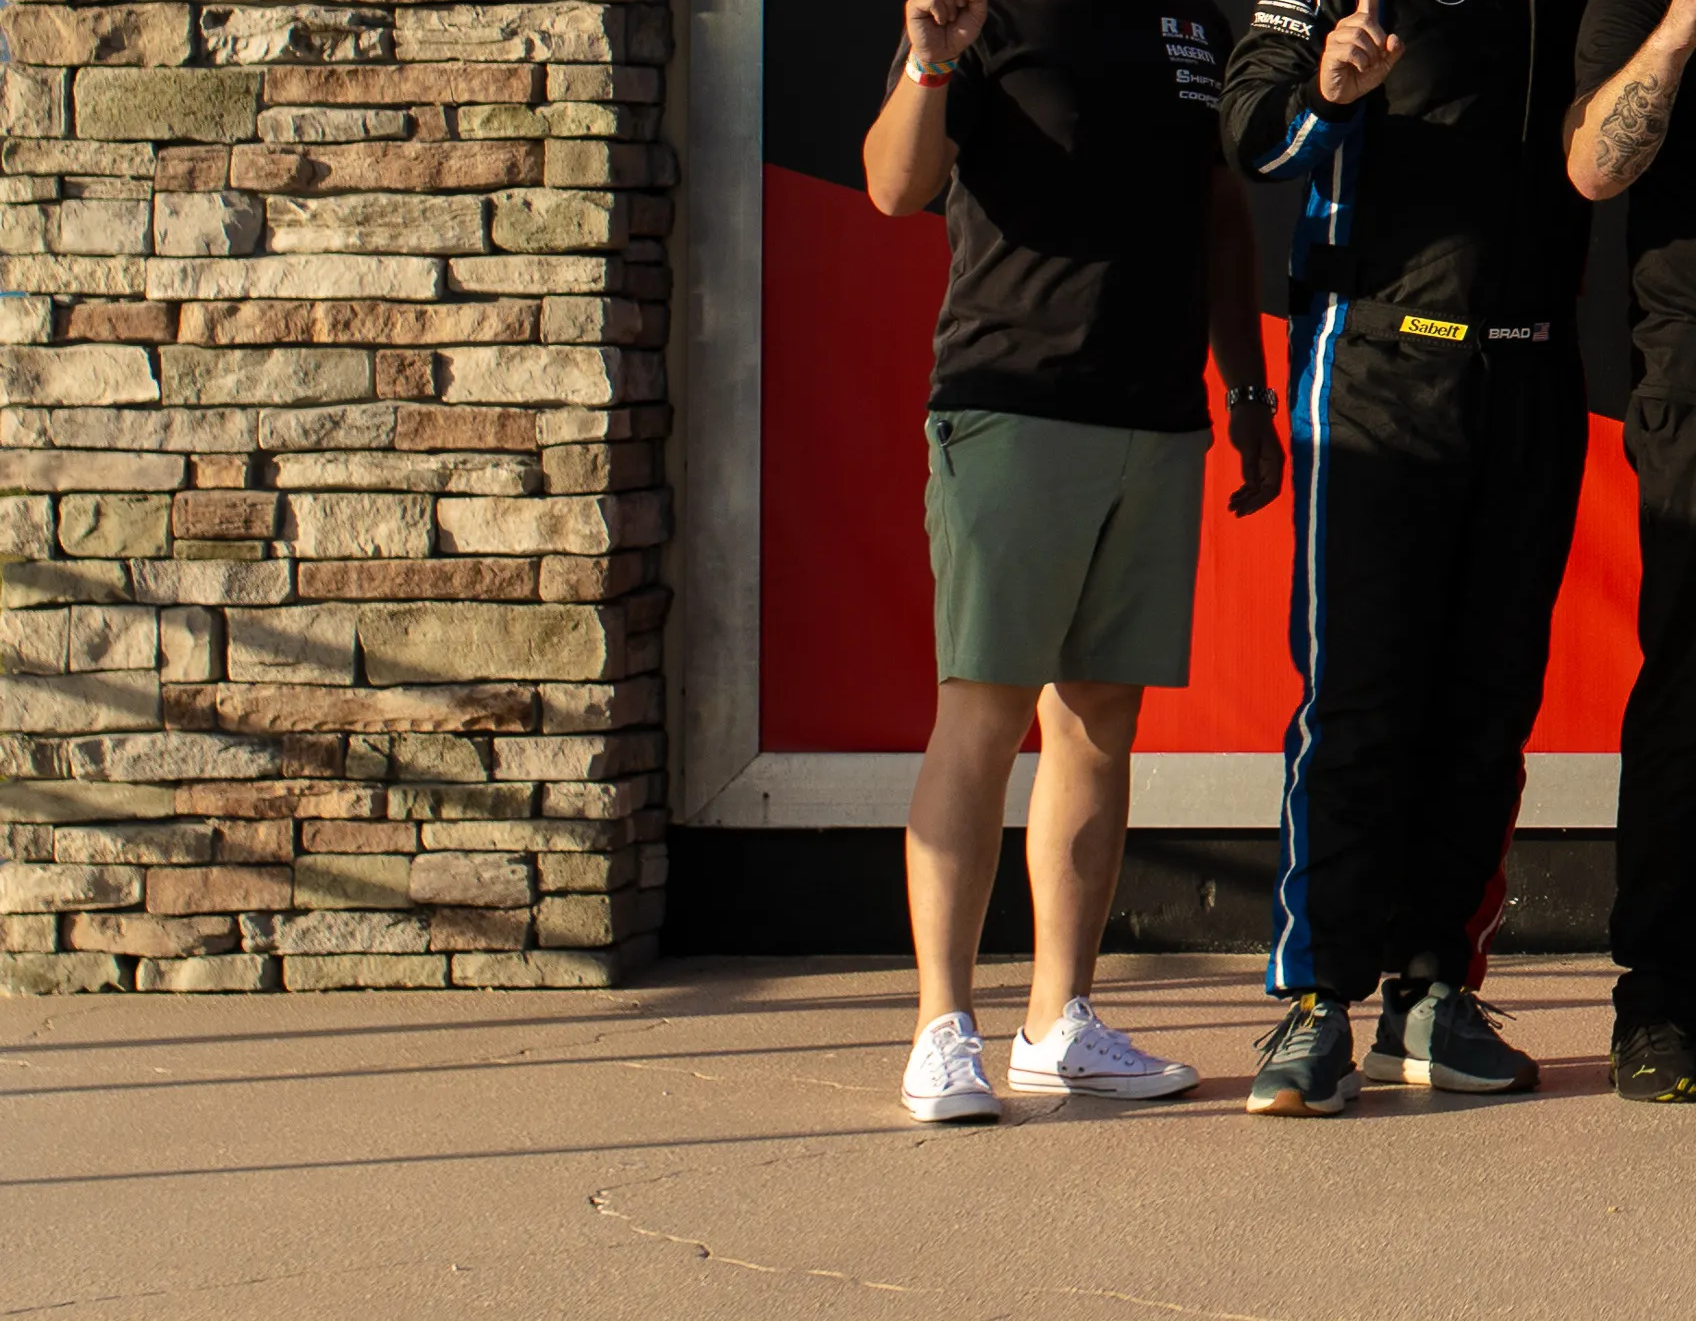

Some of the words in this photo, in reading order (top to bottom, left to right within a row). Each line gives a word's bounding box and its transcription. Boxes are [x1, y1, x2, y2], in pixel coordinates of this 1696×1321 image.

[1166, 43, 1217, 66] HAGERTY
[1408, 318, 1462, 339] Sabelt
[1487, 327, 1531, 340] BRAD
